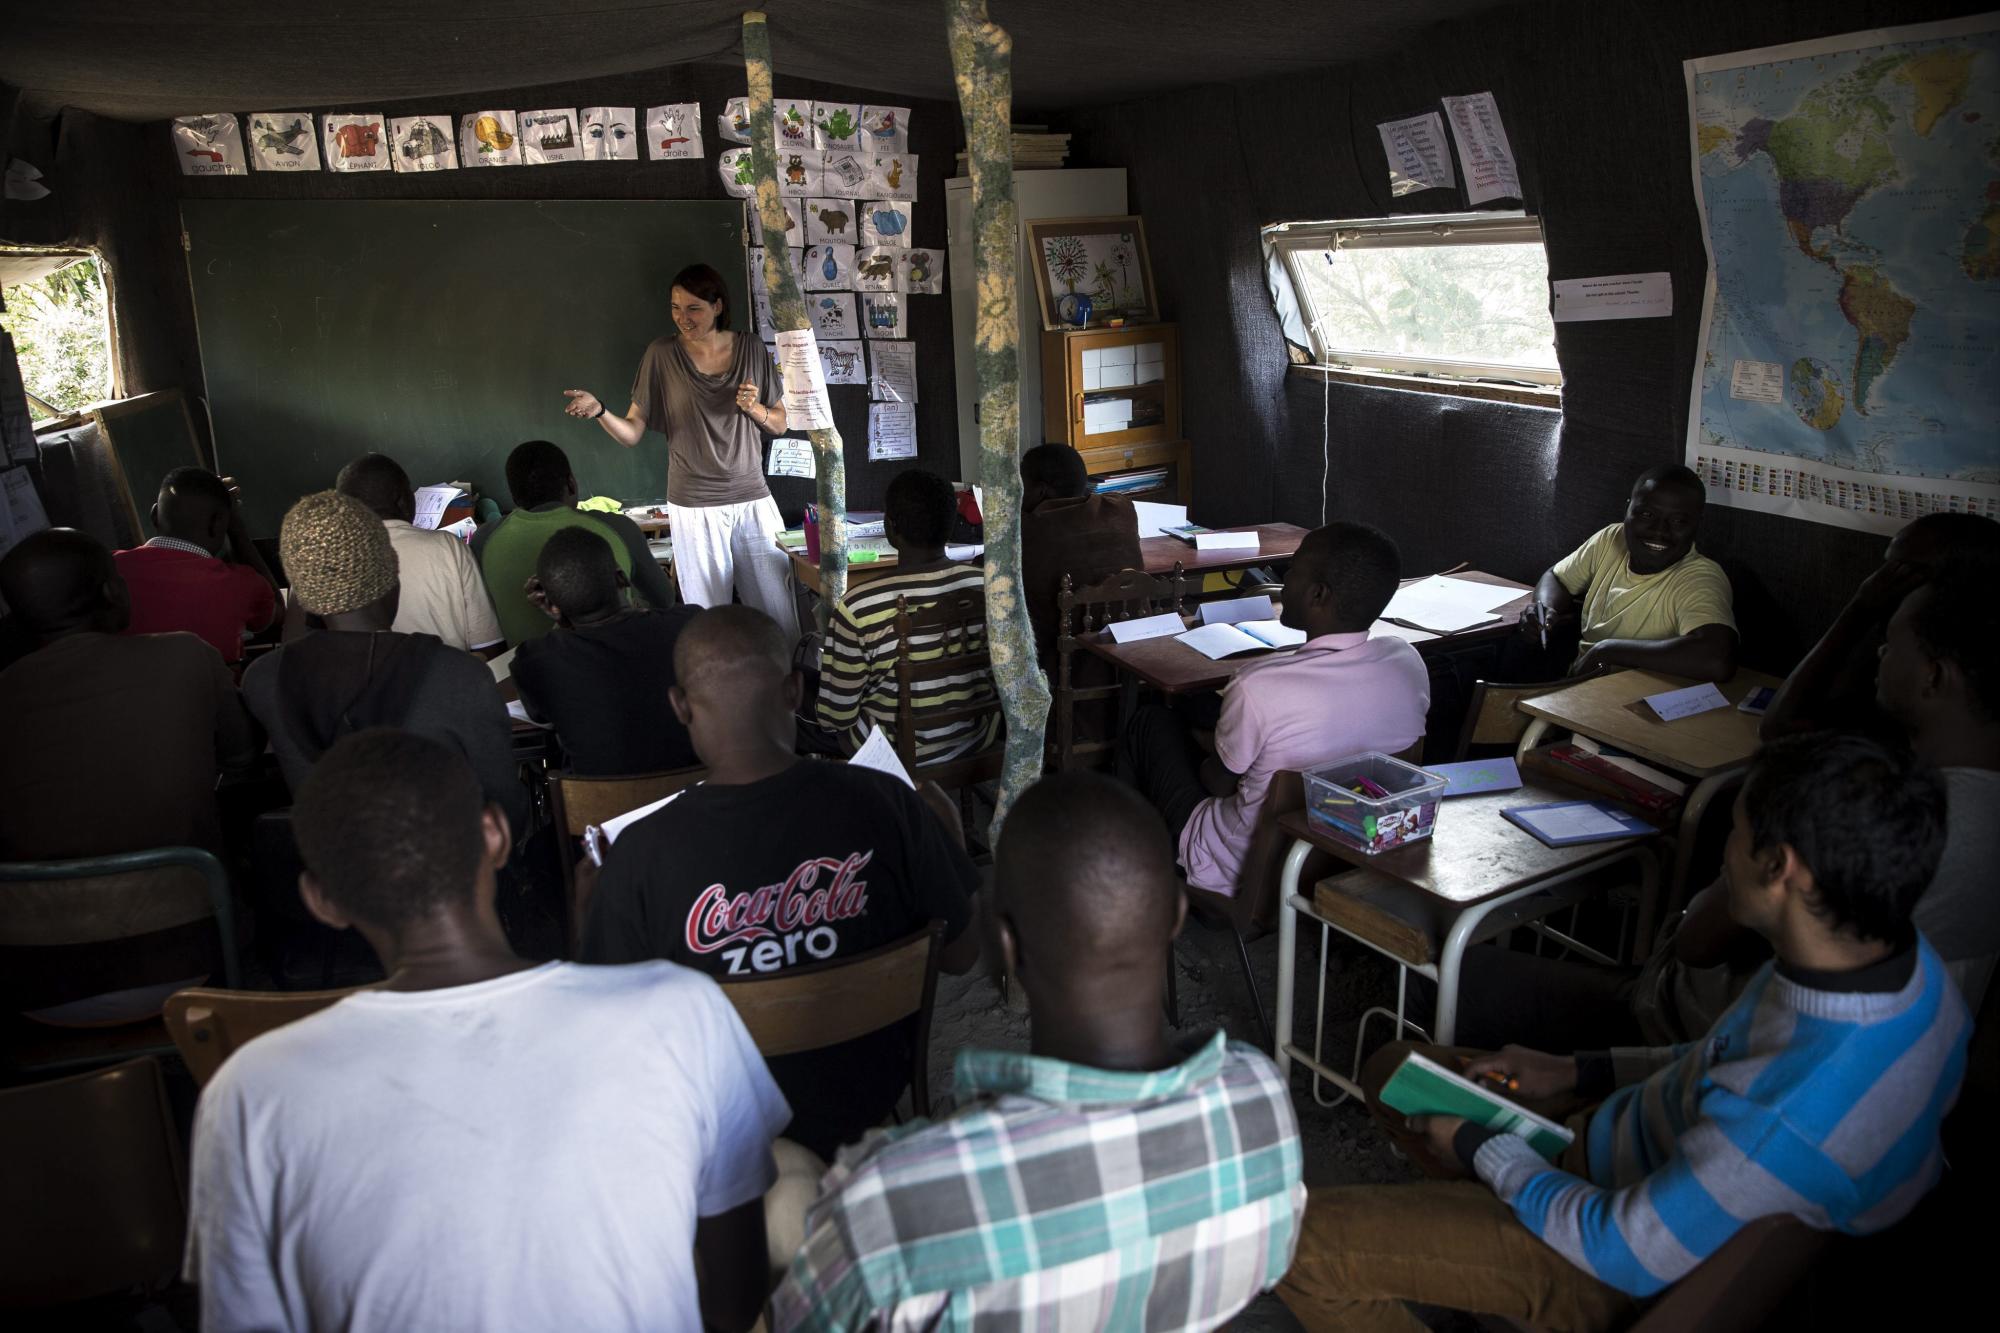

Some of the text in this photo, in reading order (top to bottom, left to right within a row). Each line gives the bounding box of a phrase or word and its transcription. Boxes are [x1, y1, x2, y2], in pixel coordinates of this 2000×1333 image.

[817, 108, 824, 117] D
[525, 118, 533, 128] U
[327, 123, 335, 133] E
[546, 153, 565, 161] USINE
[663, 149, 689, 158] droite
[479, 156, 508, 164] ORANGE
[723, 155, 732, 164] G
[826, 155, 832, 163] J
[875, 158, 882, 167] K
[191, 162, 232, 173] gauche
[275, 160, 301, 168] AVION
[834, 189, 861, 197] JOURNAL
[756, 254, 763, 263] P
[811, 250, 818, 259] Q
[901, 254, 908, 262] S
[818, 347, 824, 355] Z
[685, 849, 874, 954] Coca-Cola
[721, 926, 839, 976] zero
